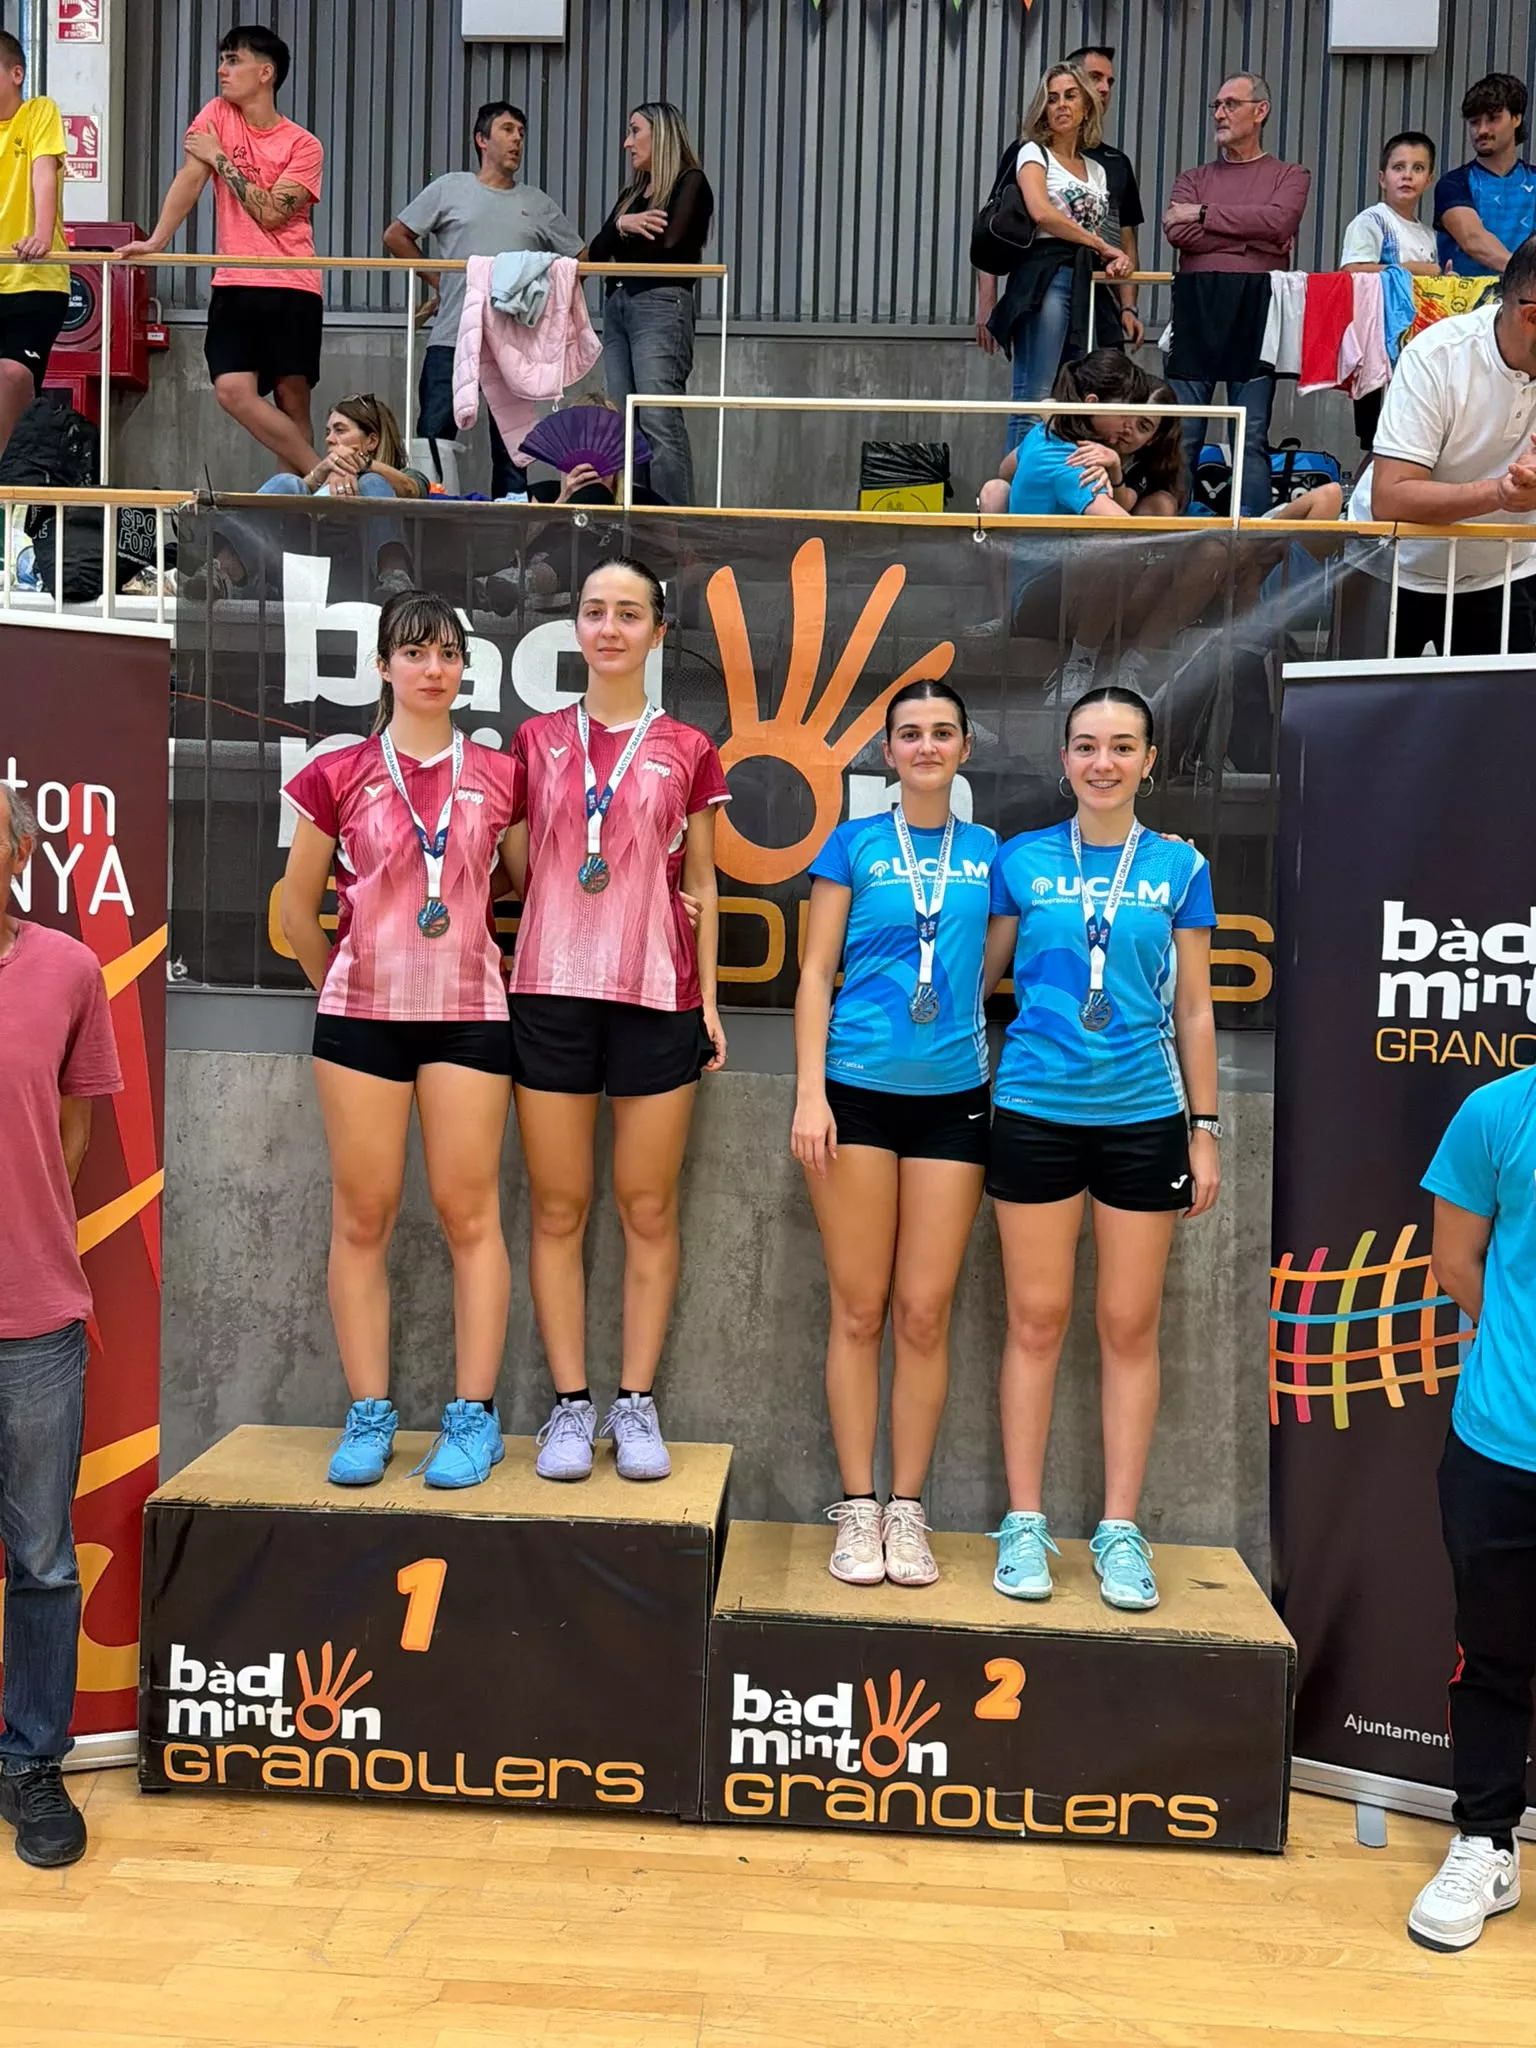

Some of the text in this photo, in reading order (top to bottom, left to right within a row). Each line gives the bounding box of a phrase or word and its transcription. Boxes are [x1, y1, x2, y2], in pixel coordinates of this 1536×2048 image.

[397, 1558, 447, 1652] 1
[169, 1643, 285, 1698] bàd
[974, 1657, 1027, 1720] 2
[167, 1696, 382, 1742] minton
[732, 1673, 853, 1730] bàd
[730, 1727, 948, 1778] minton
[1344, 1713, 1451, 1749] Ajuntament
